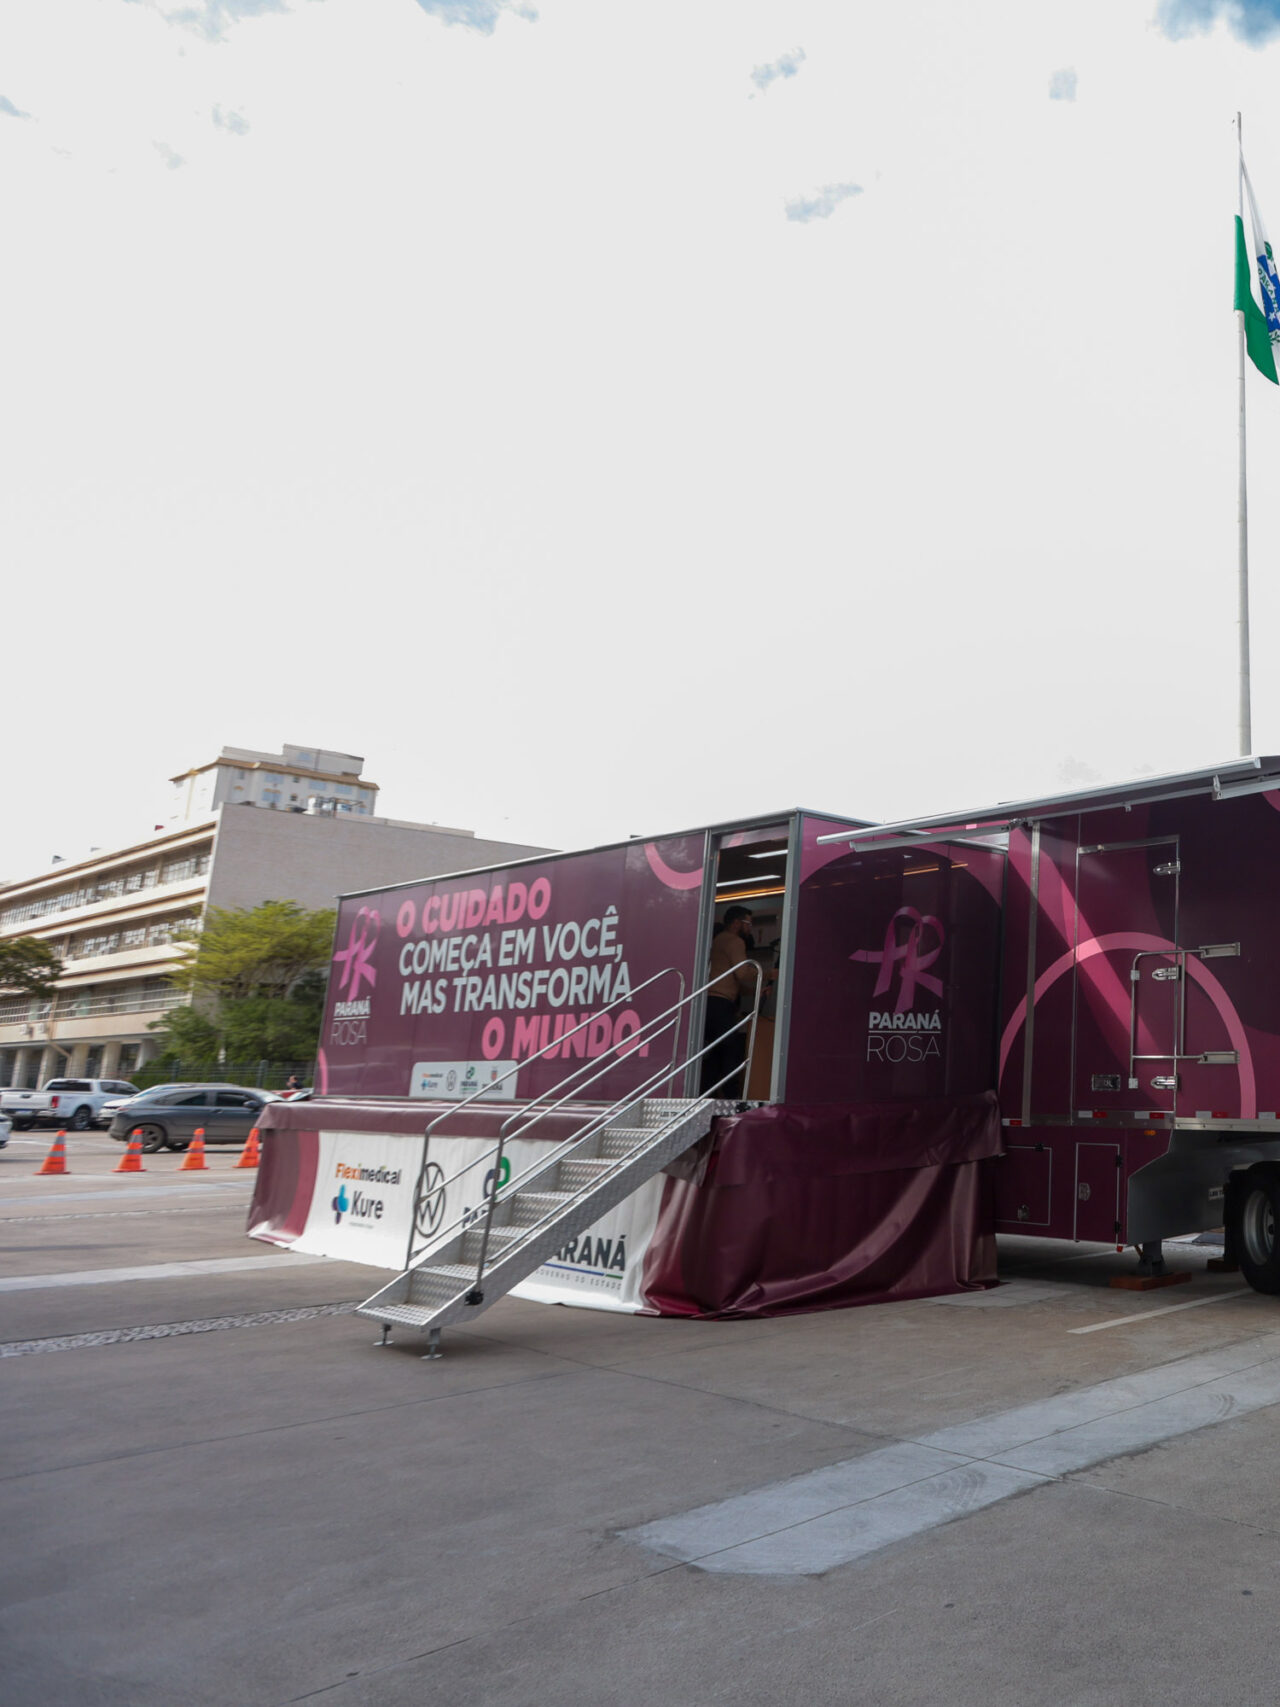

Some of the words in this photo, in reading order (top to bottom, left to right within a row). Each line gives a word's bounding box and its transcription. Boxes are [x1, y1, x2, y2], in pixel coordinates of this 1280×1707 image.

[396, 900, 416, 938] O
[422, 877, 551, 934] CUIDADO
[399, 933, 492, 976] COMEÇA
[498, 927, 536, 966] EM
[542, 905, 623, 963] VOCÊ,
[400, 979, 447, 1015] MAS
[453, 962, 632, 1013] TRANSFORMA
[334, 995, 371, 1016] PARANÁ
[868, 1009, 941, 1029] PARANÁ
[331, 1020, 368, 1046] ROSA
[481, 1017, 505, 1060] O
[511, 1009, 649, 1060] MUNDO.
[866, 1035, 941, 1062] ROSA
[335, 1162, 402, 1185] Fleximedical
[350, 1190, 384, 1219] Kure
[554, 1234, 626, 1272] RANÁ
